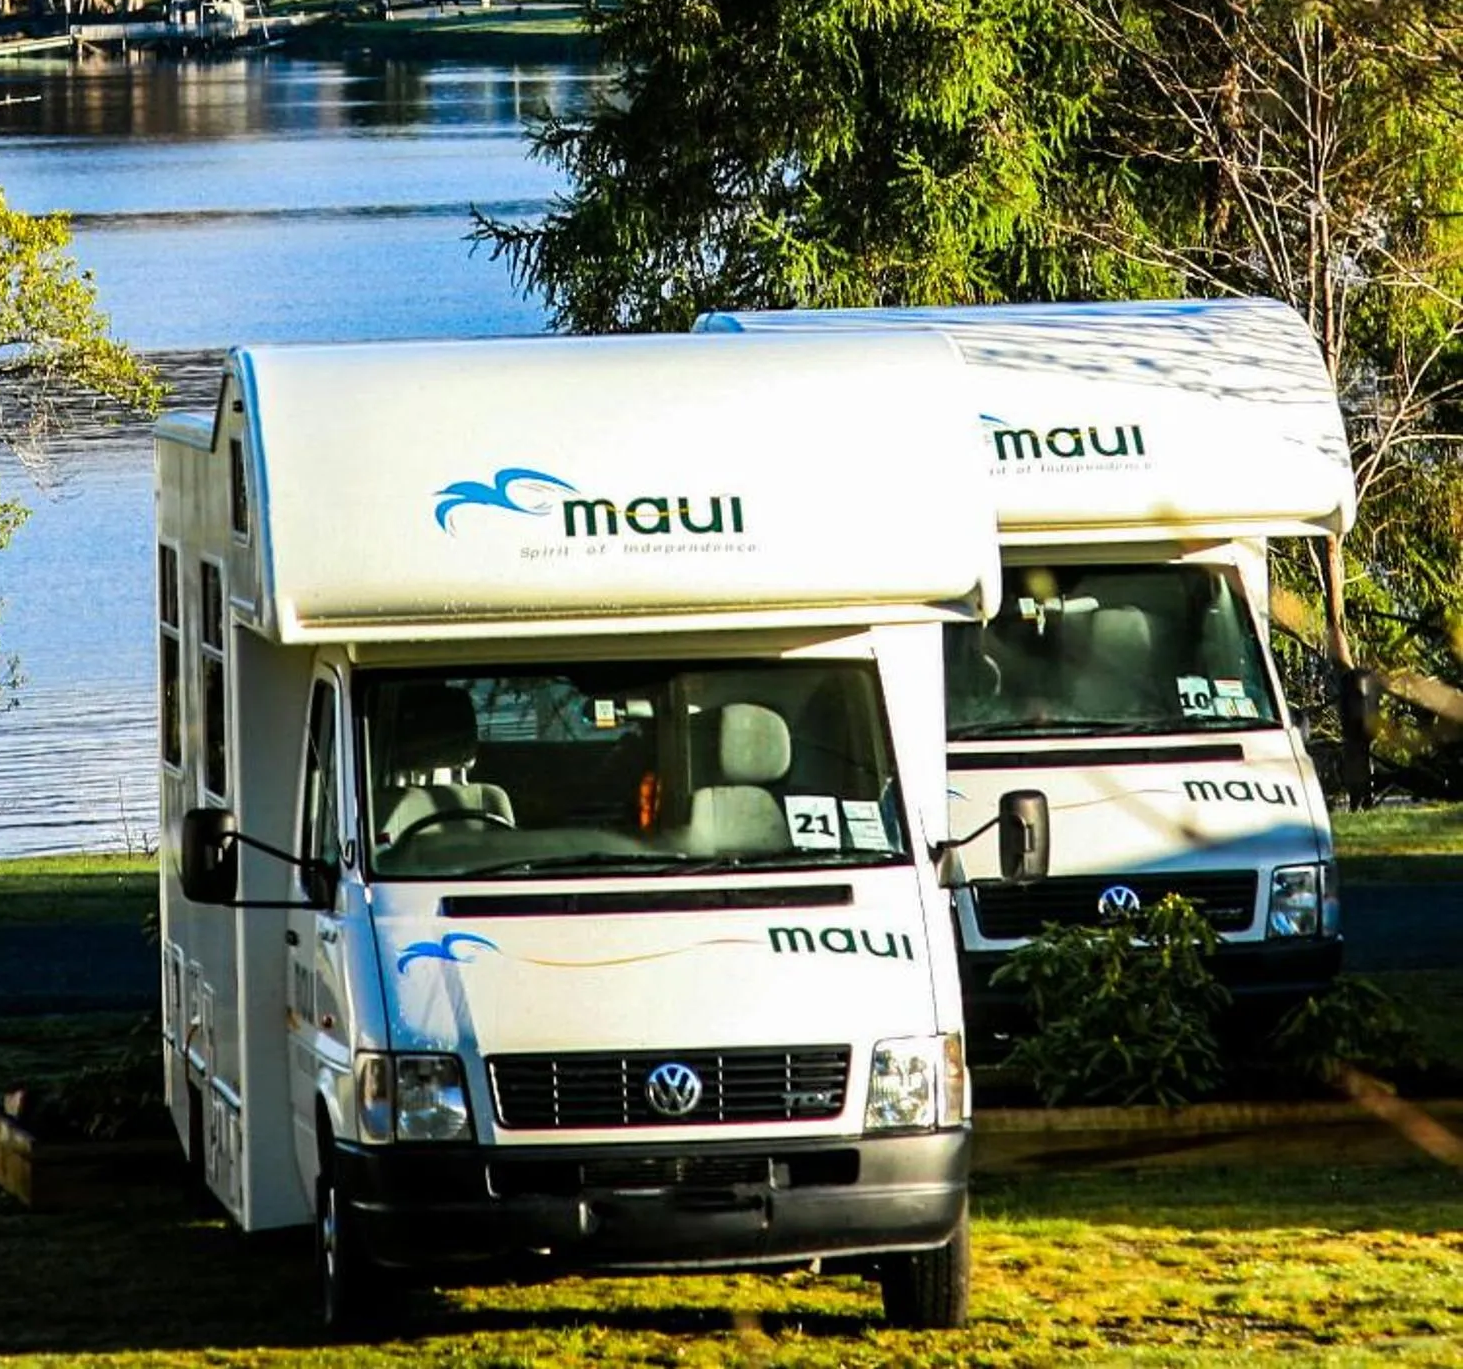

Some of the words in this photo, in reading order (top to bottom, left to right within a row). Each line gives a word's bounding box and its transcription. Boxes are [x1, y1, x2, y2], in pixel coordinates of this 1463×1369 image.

[993, 425, 1145, 460] maui
[563, 496, 744, 537] maui
[1180, 691, 1211, 710] 10
[1183, 780, 1298, 806] maui
[793, 813, 835, 837] 21
[767, 926, 914, 960] maui
